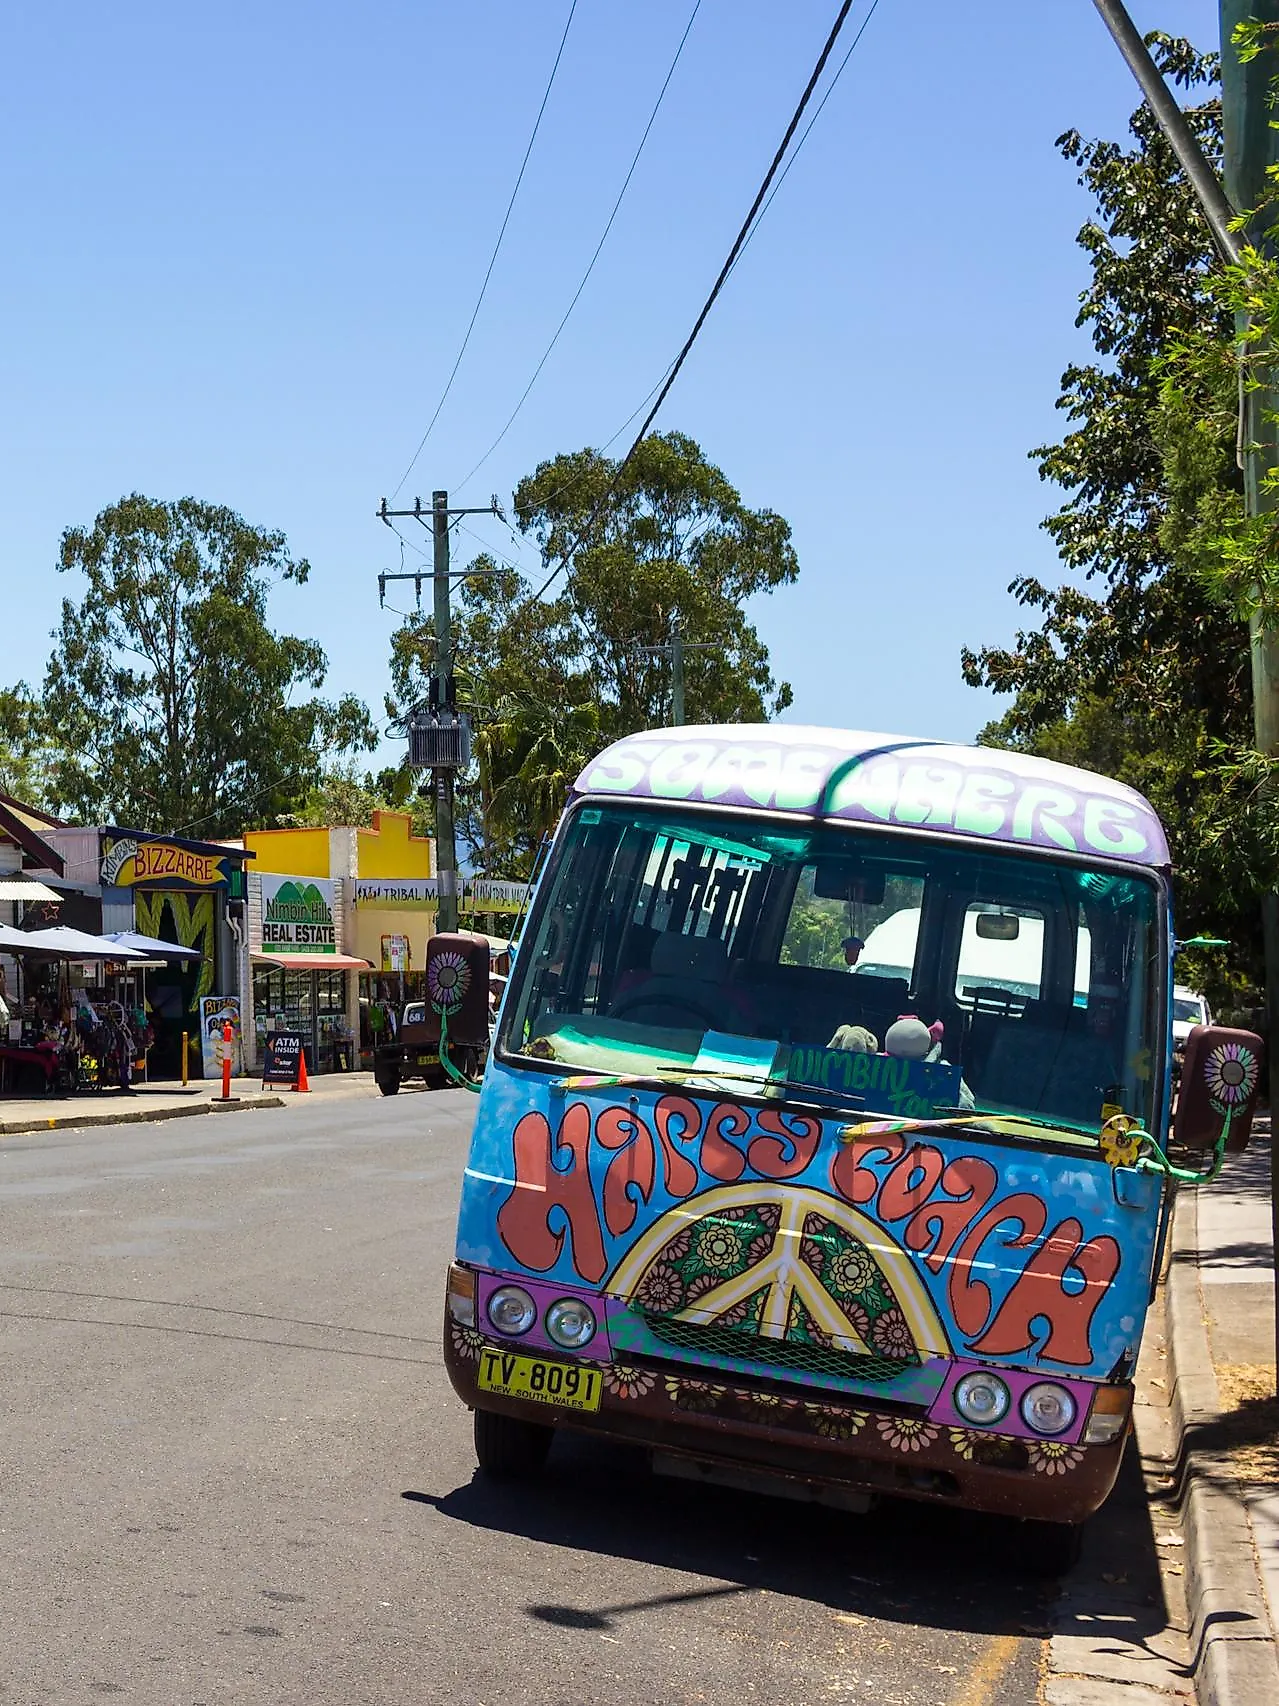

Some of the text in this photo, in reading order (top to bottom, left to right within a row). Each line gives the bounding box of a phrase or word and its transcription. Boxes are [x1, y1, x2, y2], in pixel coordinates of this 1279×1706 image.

[134, 847, 213, 880] BIZZARRE
[384, 887, 421, 901] TRIBAL
[266, 897, 332, 922] Nimbin Hills
[263, 924, 335, 943] REAL ESTATE
[275, 1037, 299, 1046] ATM
[789, 1048, 911, 1092] NIMBIN
[832, 1130, 1121, 1366] COACH
[490, 1384, 584, 1408] NEW SOUTH WALES
